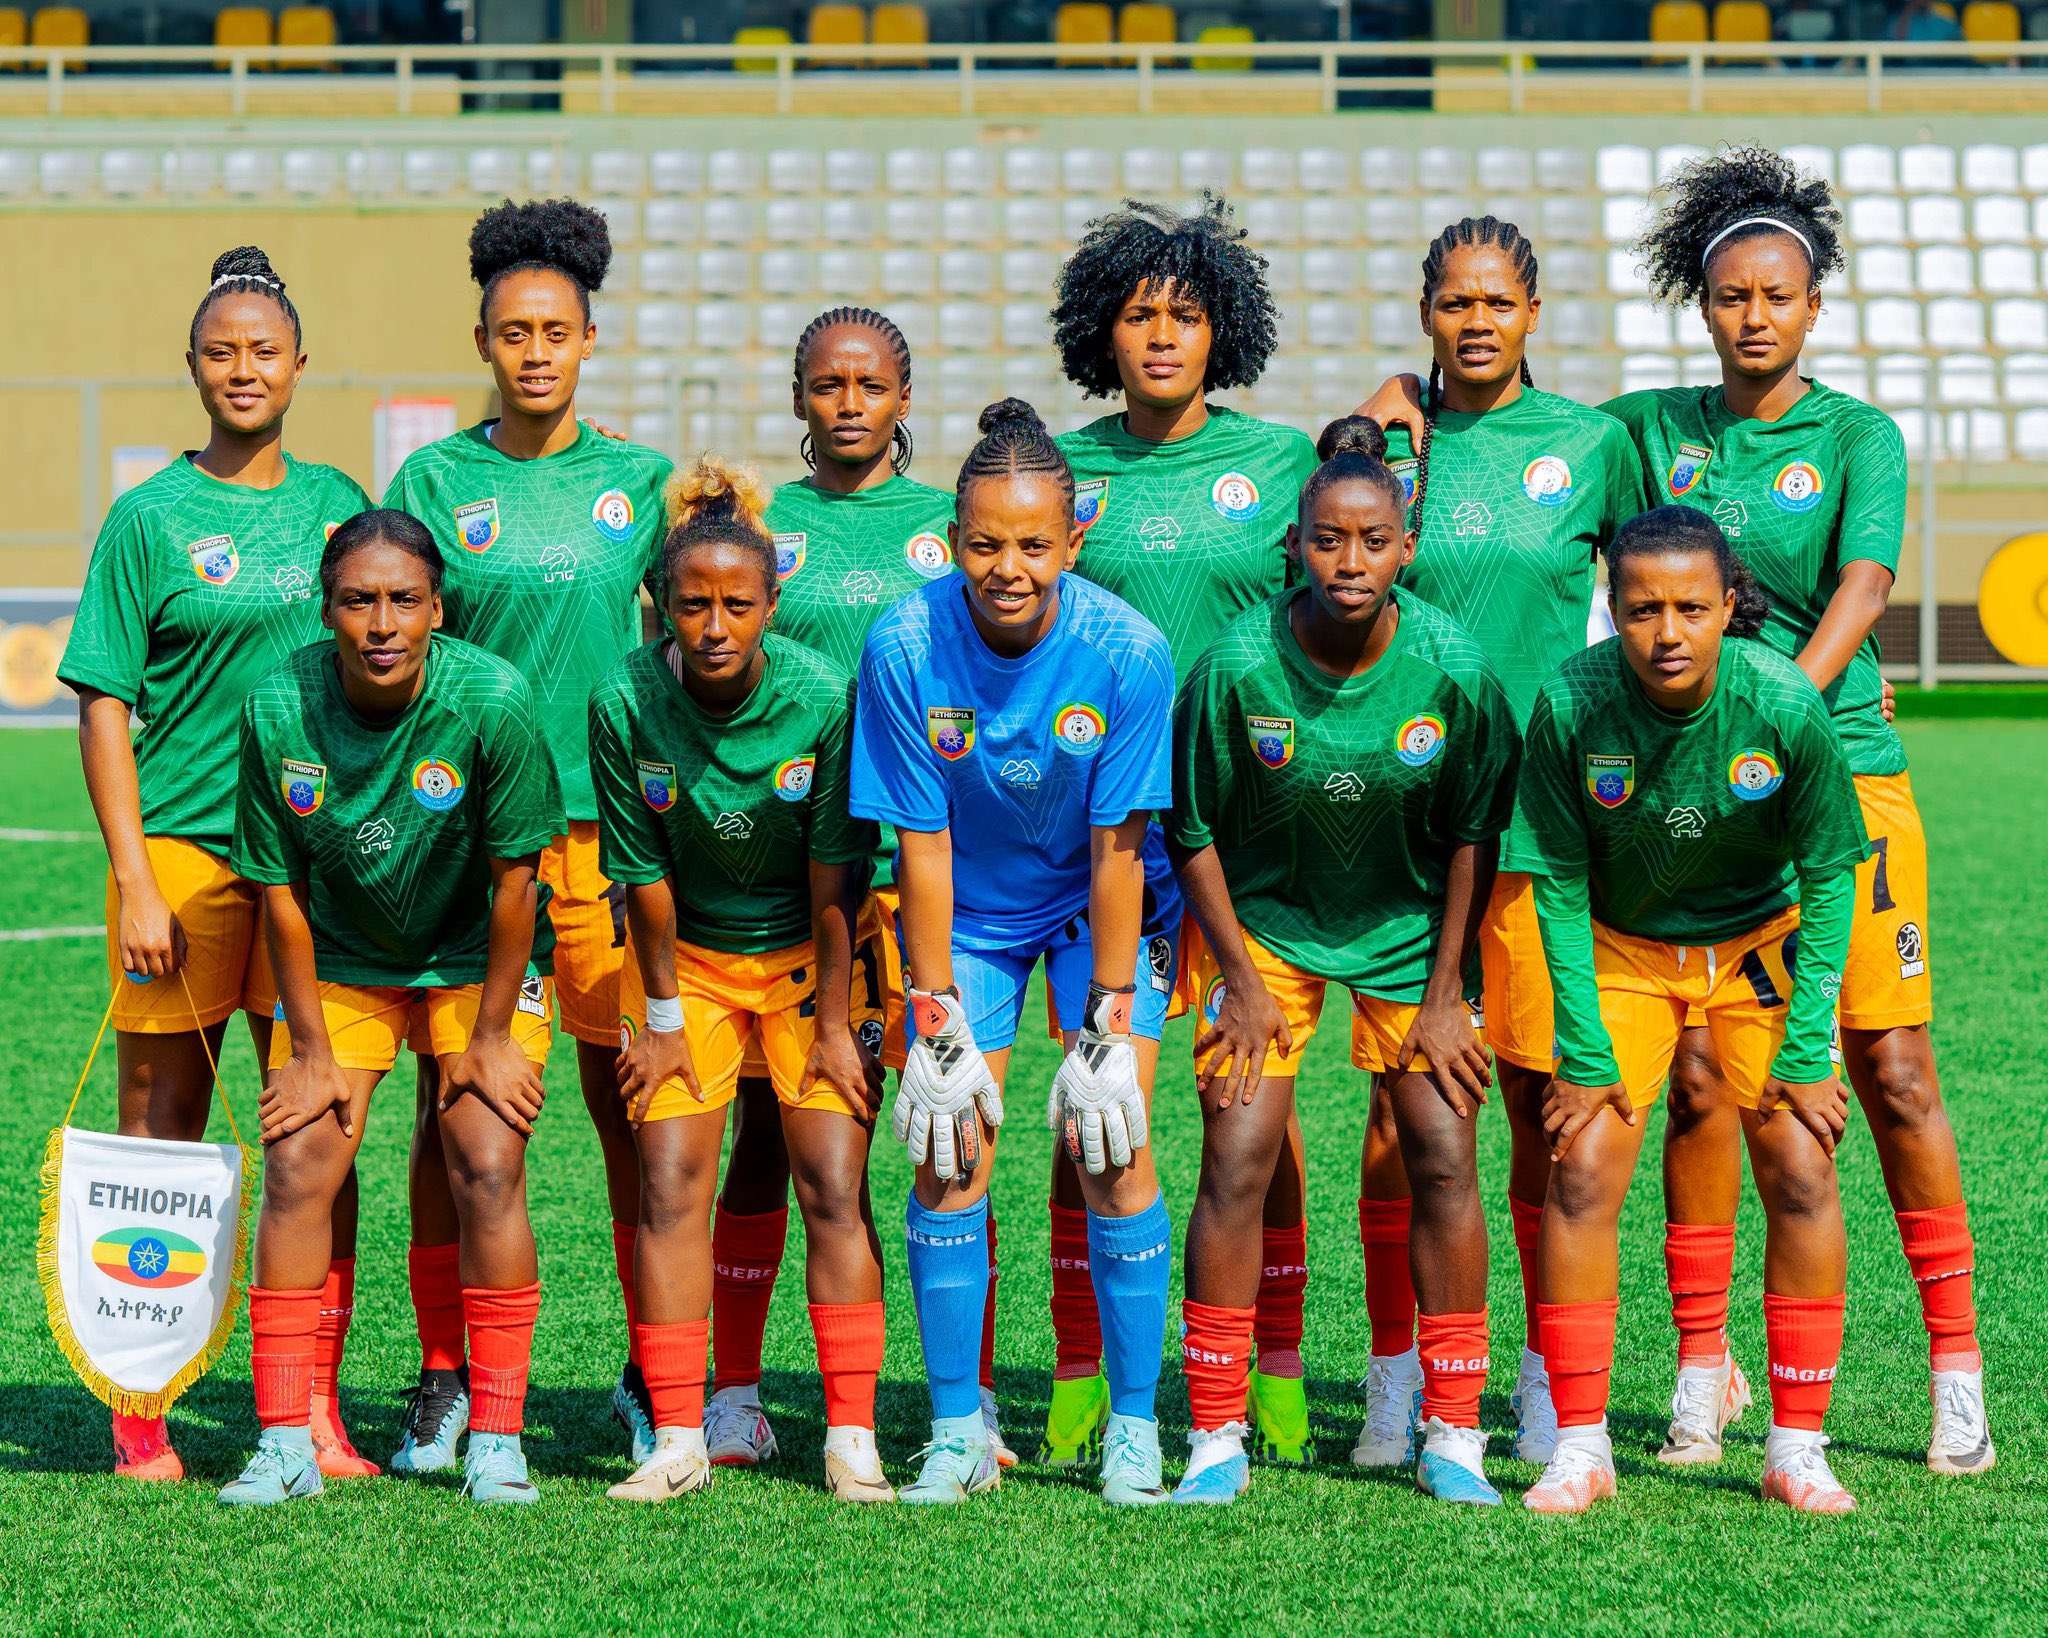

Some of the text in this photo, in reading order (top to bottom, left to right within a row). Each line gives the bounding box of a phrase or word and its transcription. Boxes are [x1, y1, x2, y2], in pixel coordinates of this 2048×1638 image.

[1680, 447, 1706, 459] ETHIOPIA
[460, 504, 492, 516] ETHIOPIA
[194, 538, 228, 551] ETHIOPIA
[1253, 720, 1287, 729] ETHIOPIA
[640, 764, 670, 774] ETHIOPIA
[1593, 759, 1628, 767] ETHIOPIA
[288, 764, 320, 777] ETHIOPIA
[1870, 837, 1896, 914] 7
[962, 1120, 977, 1161] adidas
[88, 1181, 213, 1219] ETHIOPIA
[97, 1296, 183, 1327] ኢትዮጵያ
